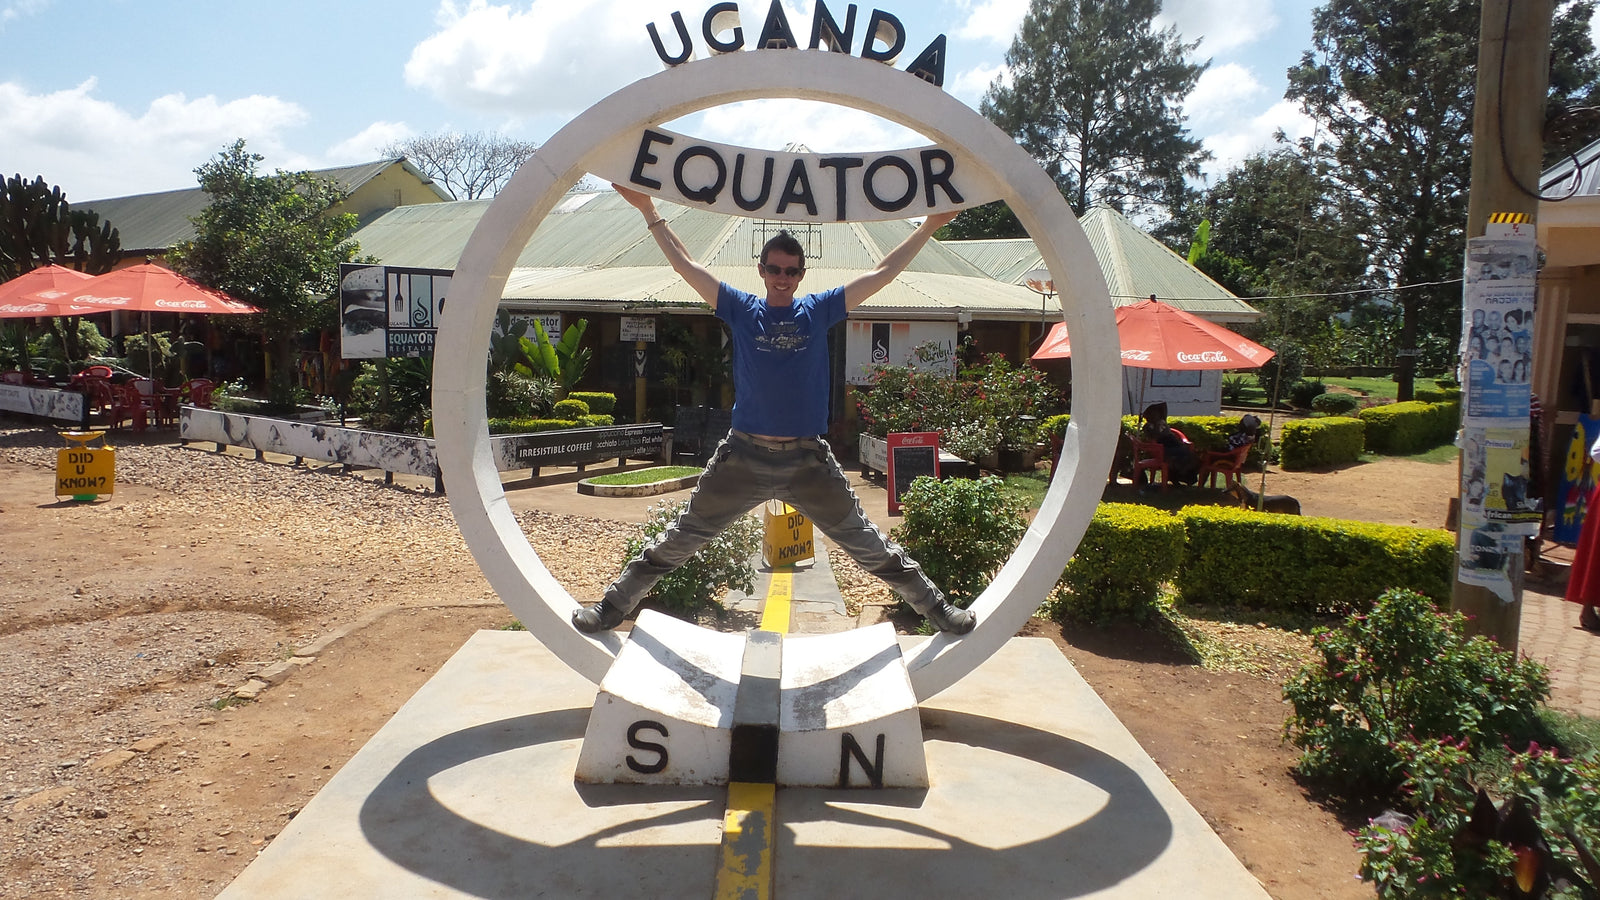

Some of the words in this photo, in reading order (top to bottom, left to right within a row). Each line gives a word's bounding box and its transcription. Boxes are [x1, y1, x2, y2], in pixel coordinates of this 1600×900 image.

[646, 0, 948, 87] UGANDA
[630, 129, 965, 222] EQUATOR
[155, 299, 208, 309] Coca-Cola
[389, 332, 433, 345] EQUATOR
[1177, 351, 1229, 363] Coca-Cola
[519, 444, 565, 458] IRRESISTIBLE
[567, 441, 592, 453] COFFEE!
[69, 453, 94, 463] DID
[76, 465, 85, 475] U
[59, 477, 106, 489] KNOW?
[788, 514, 804, 529] DID
[793, 529, 799, 541] U
[779, 540, 811, 559] KNOW?
[625, 720, 669, 774] S
[840, 732, 885, 789] N
